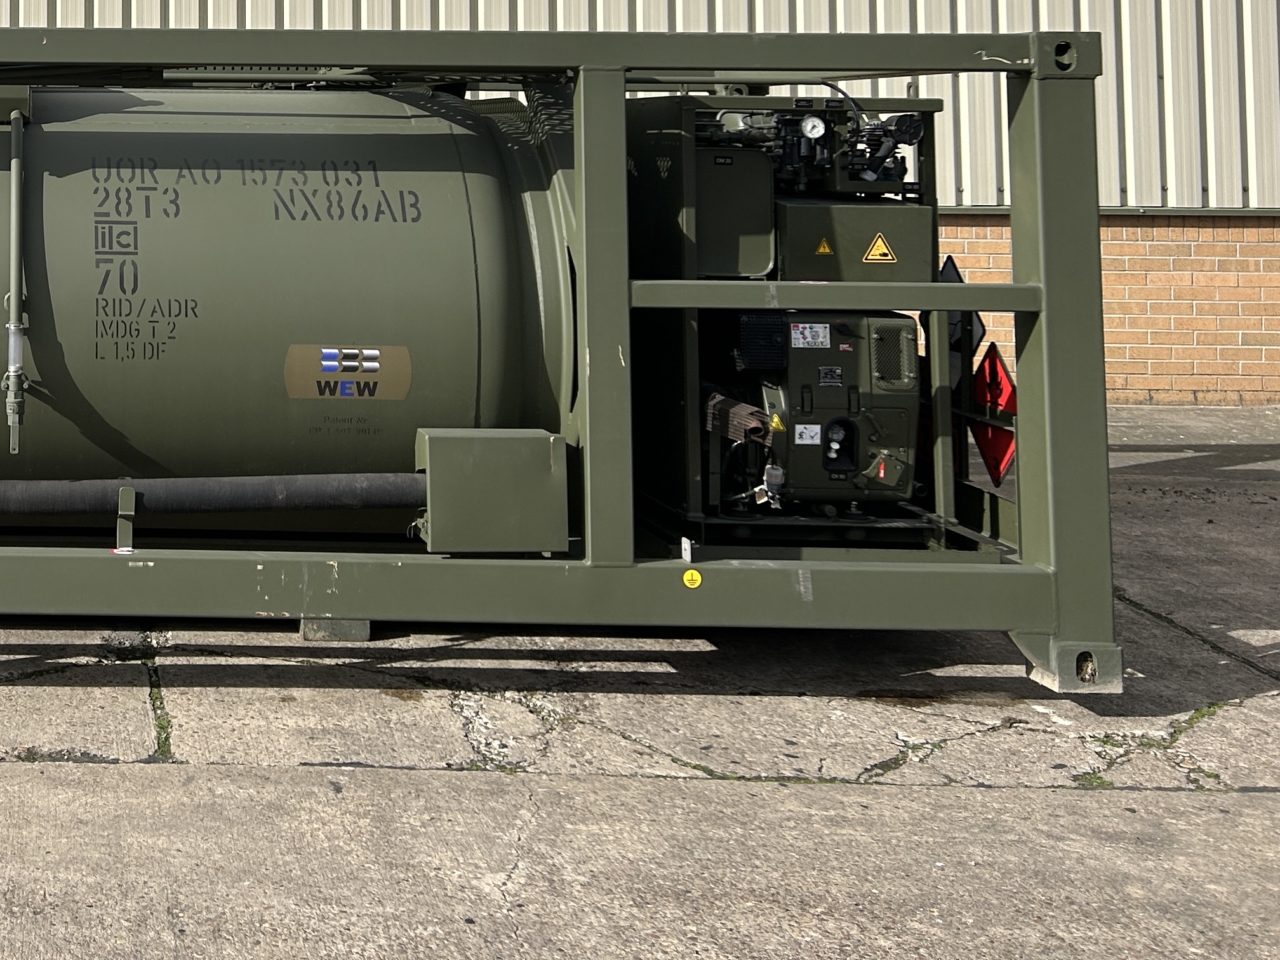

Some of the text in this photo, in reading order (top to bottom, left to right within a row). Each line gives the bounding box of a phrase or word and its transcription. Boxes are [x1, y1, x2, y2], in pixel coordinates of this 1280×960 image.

[91, 156, 160, 184] UOR
[237, 159, 309, 186] 1573
[321, 160, 381, 187] 031
[93, 186, 181, 218] 28T3
[273, 188, 422, 223] NX86AB
[95, 258, 139, 296] 70
[95, 297, 199, 319] RID/ADR
[95, 319, 177, 340] IMDG T 2
[95, 341, 167, 362] L 1,5 DF
[316, 380, 379, 397] WEW
